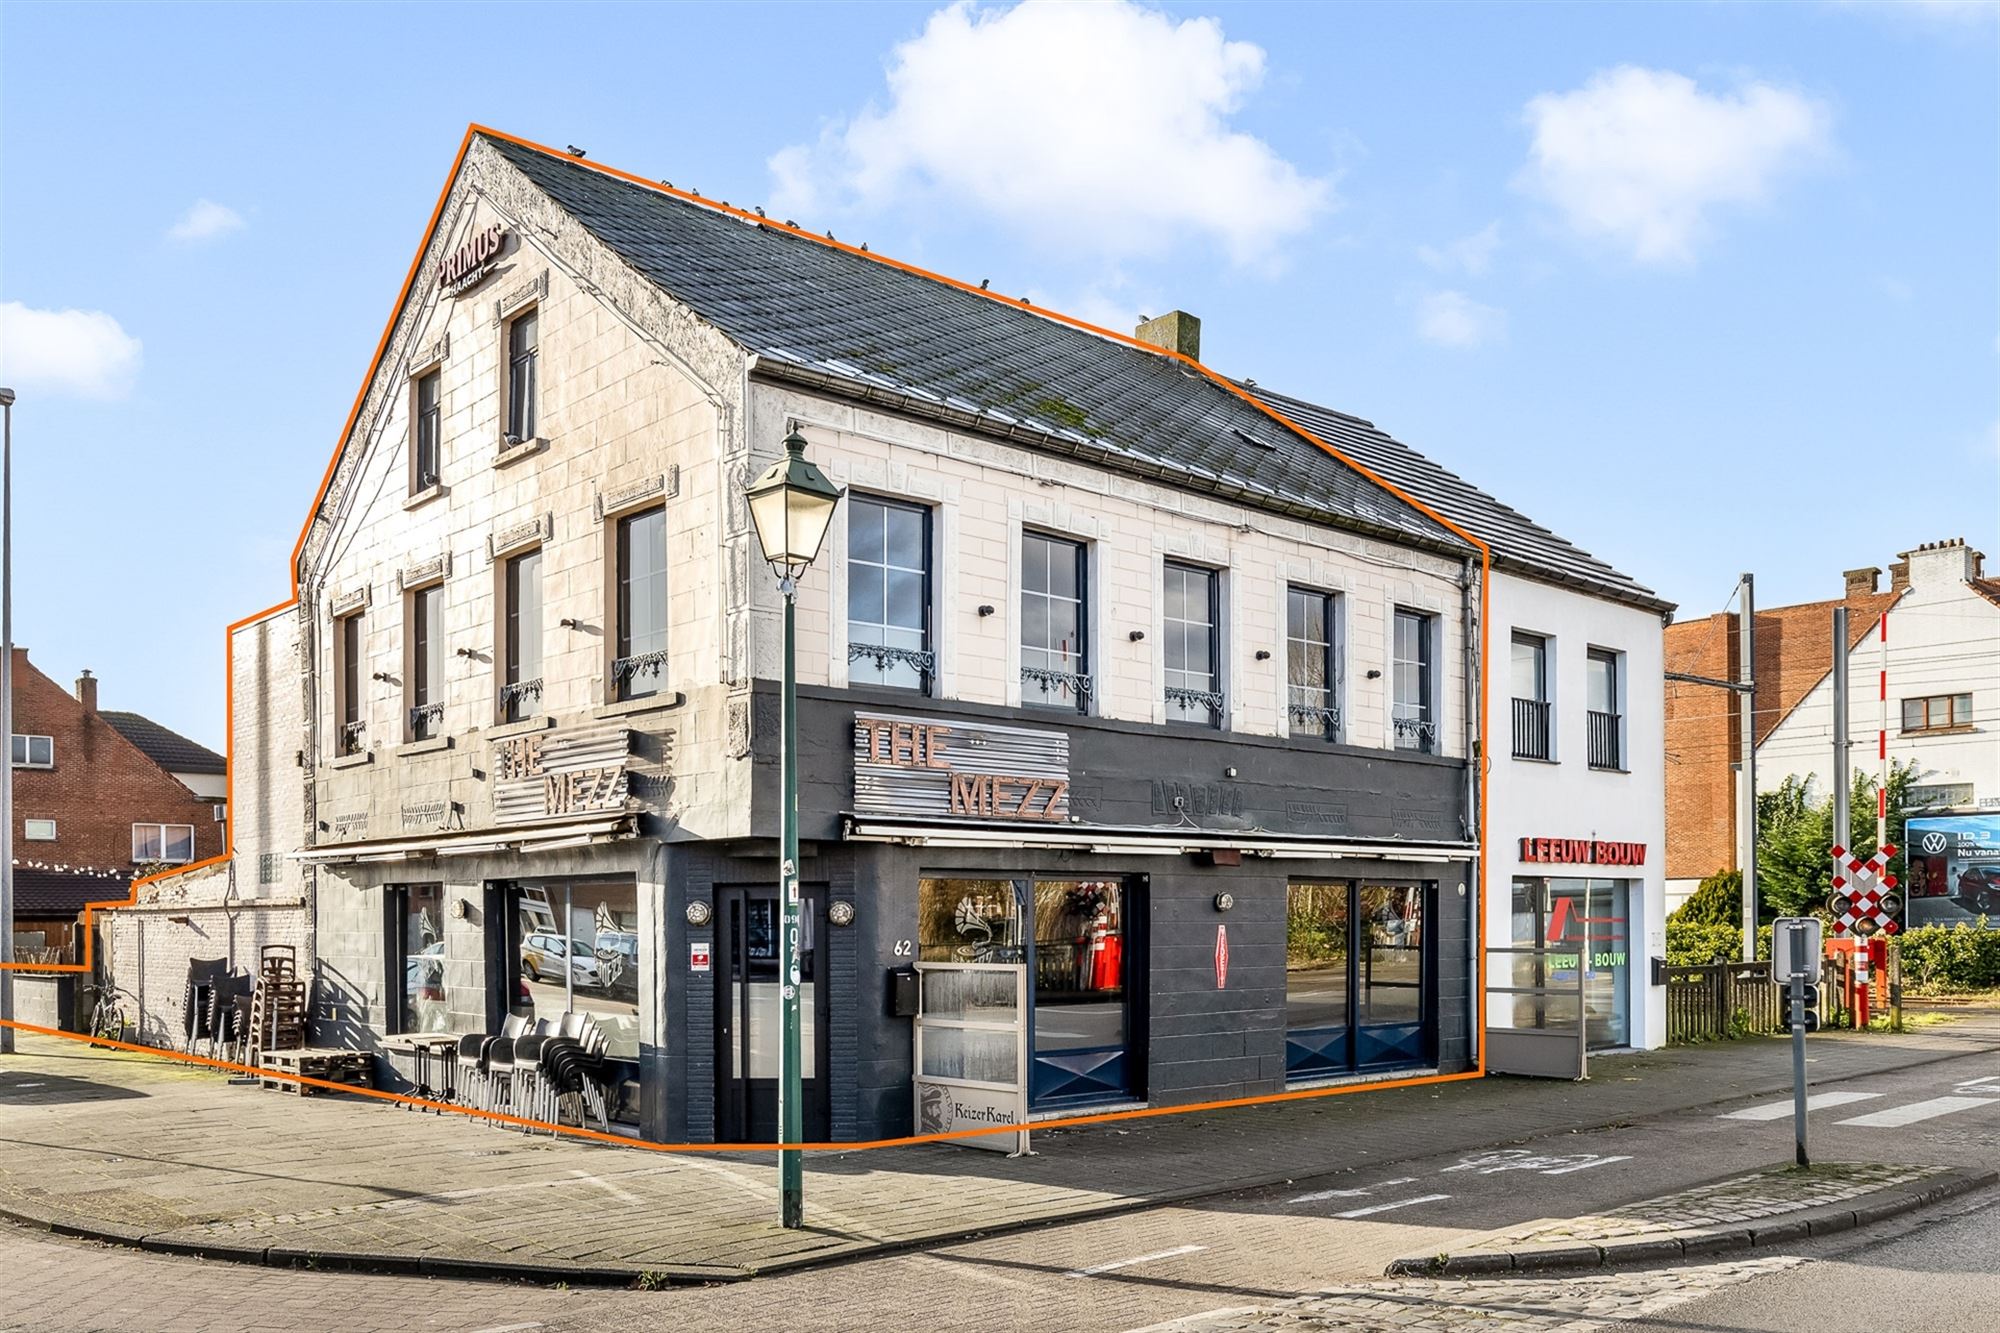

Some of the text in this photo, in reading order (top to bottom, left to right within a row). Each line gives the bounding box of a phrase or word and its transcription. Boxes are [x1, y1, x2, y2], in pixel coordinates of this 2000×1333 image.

[438, 223, 502, 290] PRIMUS
[449, 264, 485, 296] HAACHT
[500, 735, 544, 780] THE
[858, 719, 952, 769] THE
[543, 765, 623, 815] MEZZ
[951, 772, 1068, 822] MEZZ
[1522, 838, 1647, 866] LEEUW BOUW
[1957, 848, 2000, 857] Nu vana
[894, 940, 911, 956] 62
[1595, 952, 1626, 967] BOUW
